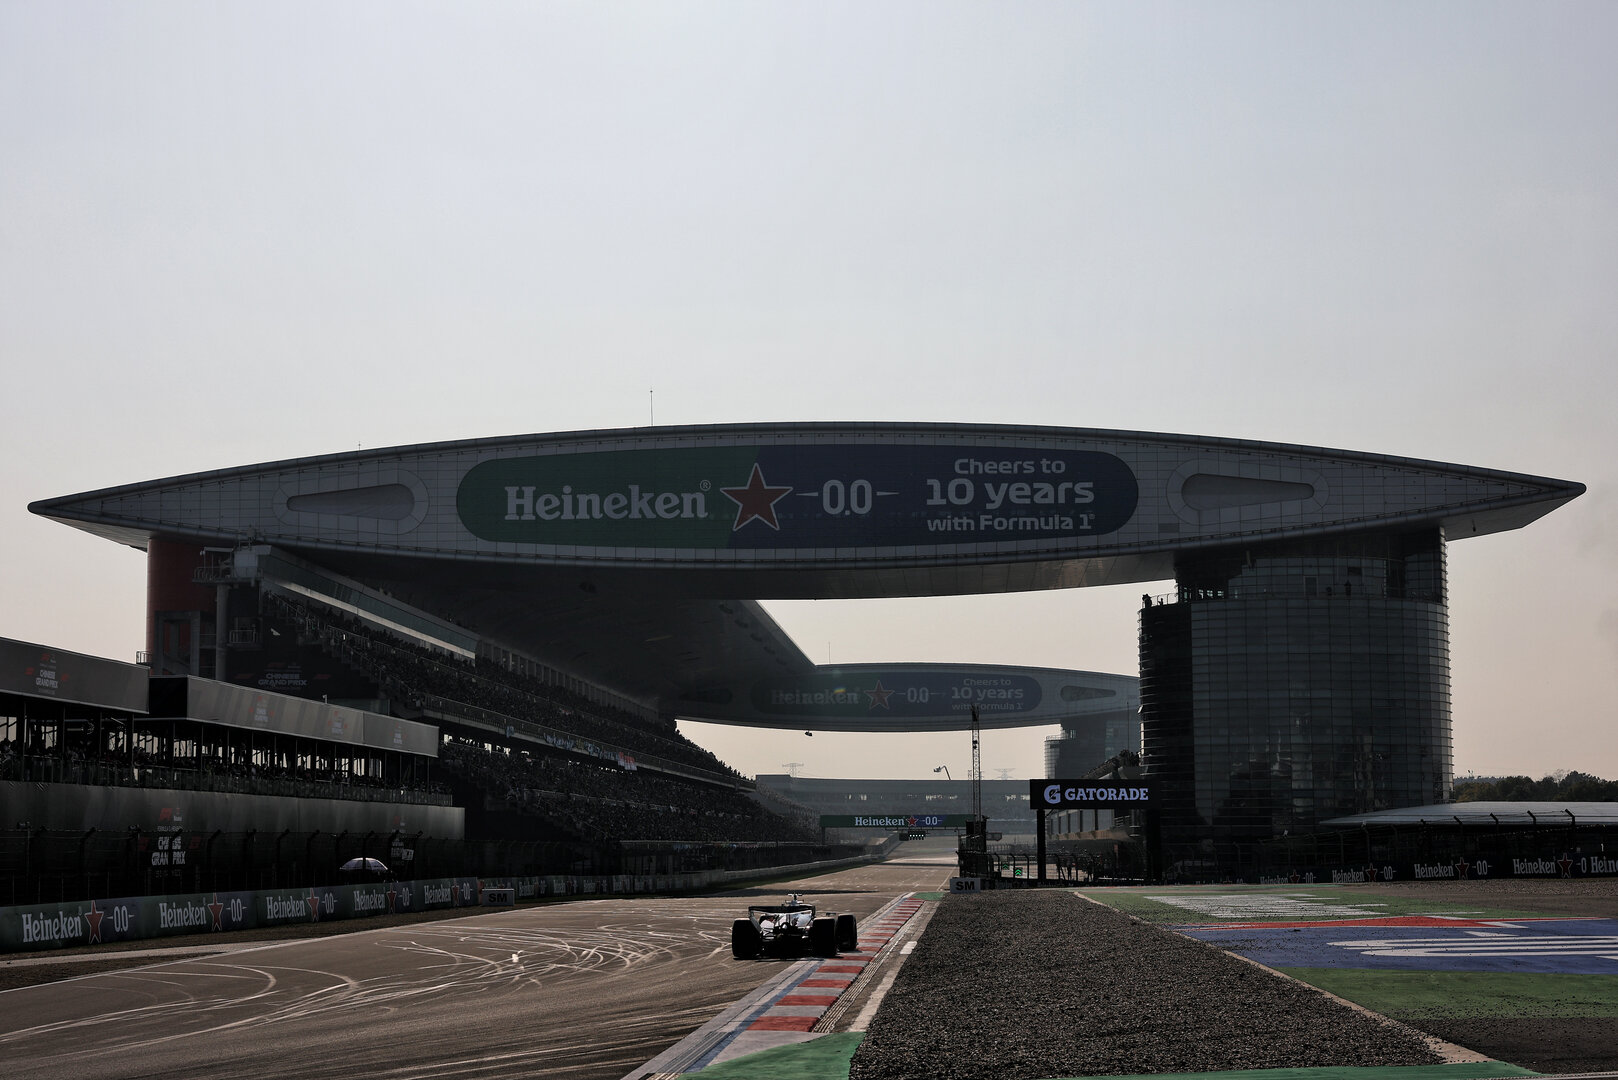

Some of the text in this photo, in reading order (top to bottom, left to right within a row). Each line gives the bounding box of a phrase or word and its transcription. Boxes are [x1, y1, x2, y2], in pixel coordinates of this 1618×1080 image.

[954, 458, 1066, 475] Cheers to
[926, 478, 1094, 510] 10 years
[926, 515, 975, 531] with
[980, 514, 1074, 531] Formula
[963, 678, 1012, 687] Cheers to
[951, 686, 1025, 701] 10 years
[1064, 788, 1149, 801] GATORADE
[855, 816, 905, 826] Heineken
[1414, 862, 1454, 879] Heineken
[1512, 857, 1556, 874] Heineken
[956, 881, 975, 891] SM
[488, 893, 507, 903] SM
[159, 900, 206, 929] Heineken
[266, 894, 305, 920] Heineken
[22, 911, 82, 943] Heineken
